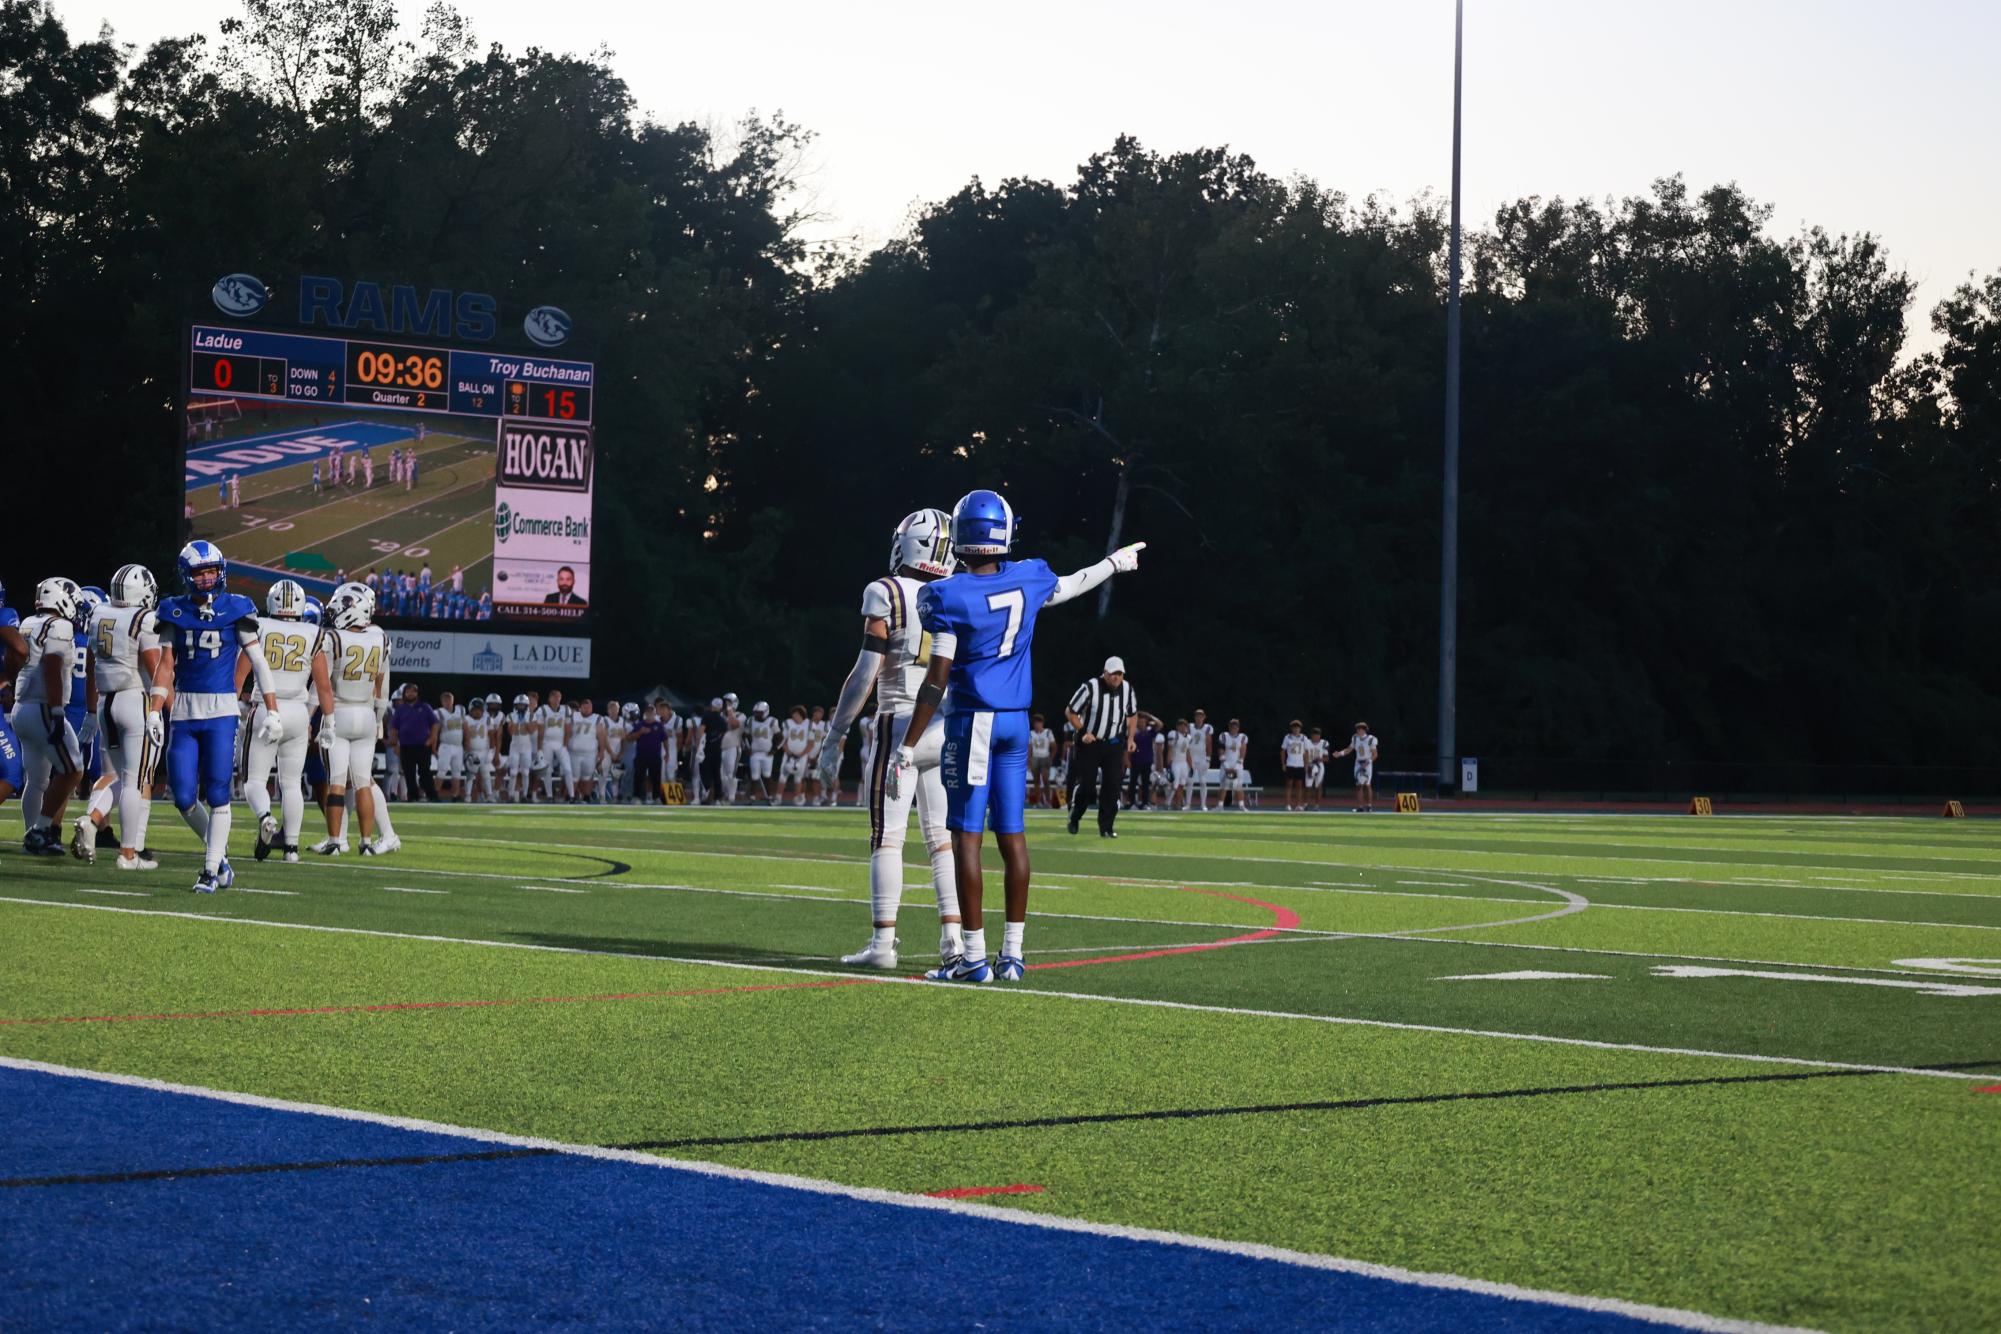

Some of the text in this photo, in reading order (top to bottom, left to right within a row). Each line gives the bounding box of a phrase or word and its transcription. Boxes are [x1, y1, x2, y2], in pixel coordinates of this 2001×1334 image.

[300, 275, 496, 341] RAMS
[195, 331, 243, 350] Ladue
[214, 358, 232, 389] 0
[290, 368, 336, 381] DOWN 4
[357, 351, 443, 388] 09:36
[489, 359, 591, 382] Troy Buchanan
[270, 384, 278, 394] 3
[289, 384, 336, 398] TO GO 7
[458, 381, 495, 395] BALL ON
[372, 391, 426, 407] Quarter 2
[512, 403, 520, 414] 2
[544, 389, 577, 419] 15
[185, 435, 359, 482] ADUE
[504, 433, 587, 481] HOGAN
[512, 511, 589, 538] Commerce Bank
[918, 562, 949, 576] Riddell
[497, 605, 522, 615] CALL
[984, 586, 1026, 660] 7
[97, 618, 117, 659] 5
[184, 629, 222, 661] 14
[396, 637, 442, 652] Beyond
[264, 632, 306, 672] 62
[390, 655, 431, 669] udents
[513, 643, 584, 664] LADUE
[342, 645, 381, 682] 24
[944, 742, 960, 789] RAMS
[1466, 771, 1473, 782] D
[667, 786, 684, 801] 40
[1402, 794, 1417, 812] 40
[1697, 798, 1710, 814] 30
